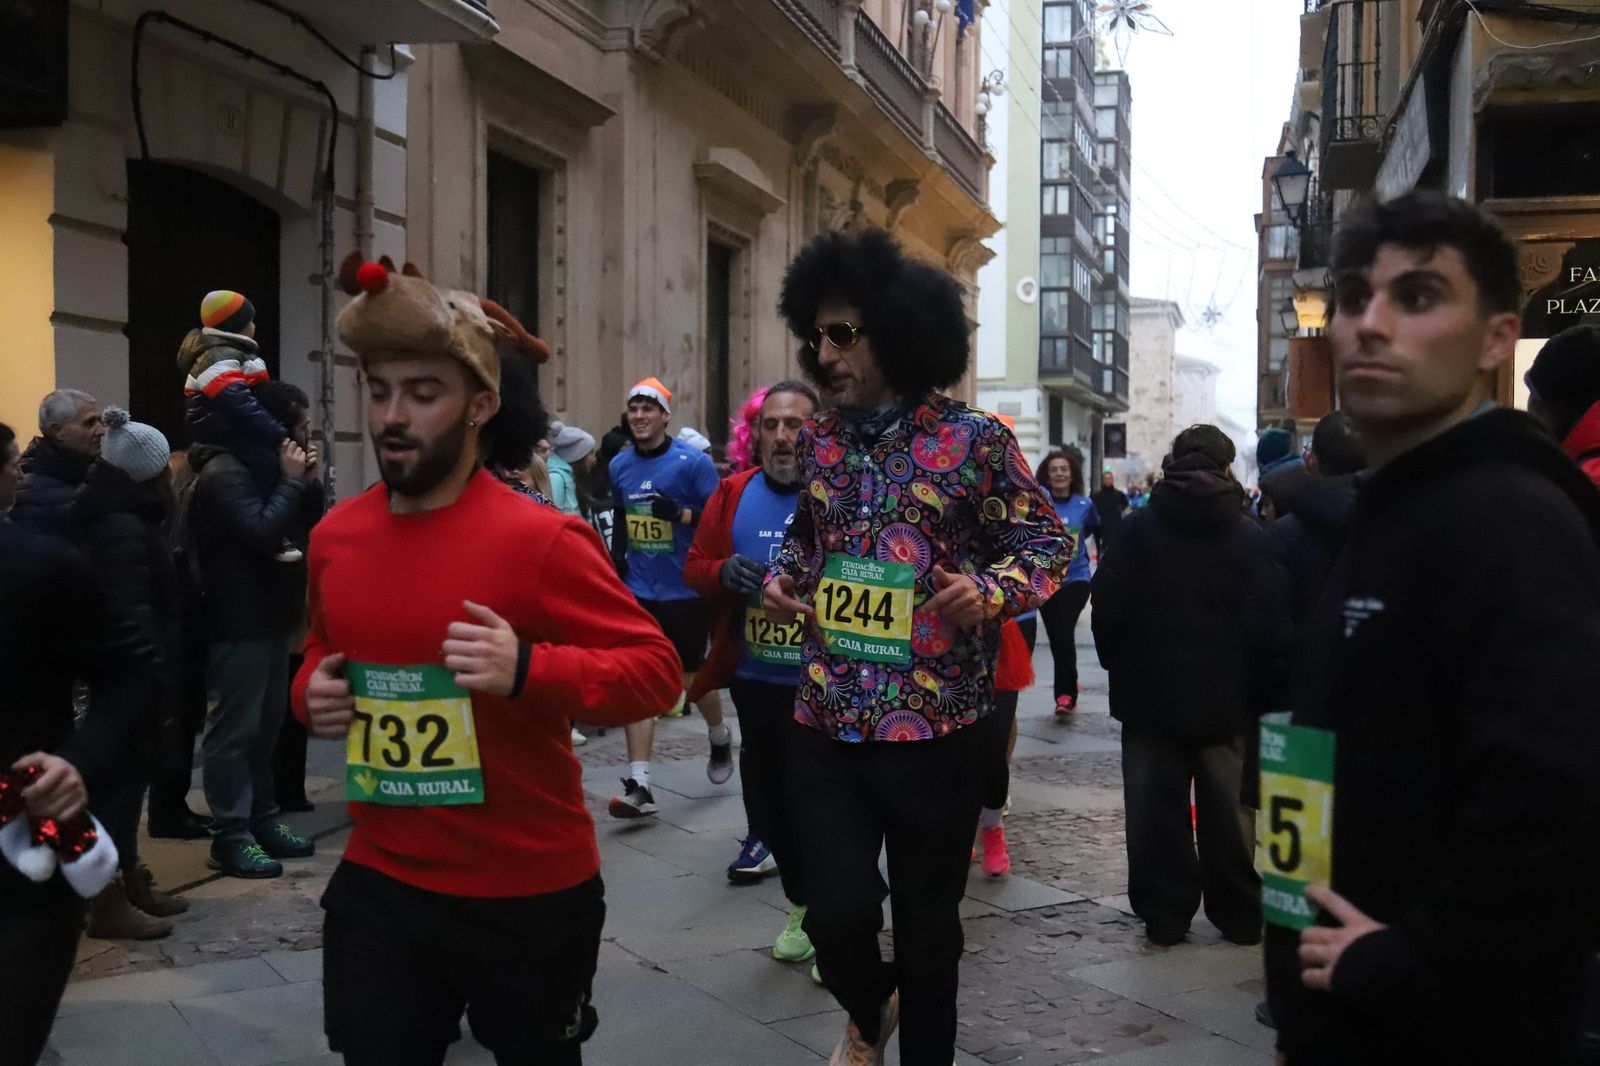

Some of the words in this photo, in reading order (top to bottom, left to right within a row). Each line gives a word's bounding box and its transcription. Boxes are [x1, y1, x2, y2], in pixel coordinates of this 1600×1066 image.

[1569, 266, 1600, 282] FA
[640, 480, 652, 490] 46
[630, 520, 663, 540] 715
[758, 530, 773, 538] SAN
[822, 582, 895, 631] 1244
[749, 615, 804, 647] 1252
[762, 649, 782, 659] CAJA
[837, 637, 862, 652] CAJA
[863, 642, 903, 657] RURAL
[353, 709, 455, 768] 732
[379, 779, 415, 796] CAJA
[416, 779, 476, 796] RURAL
